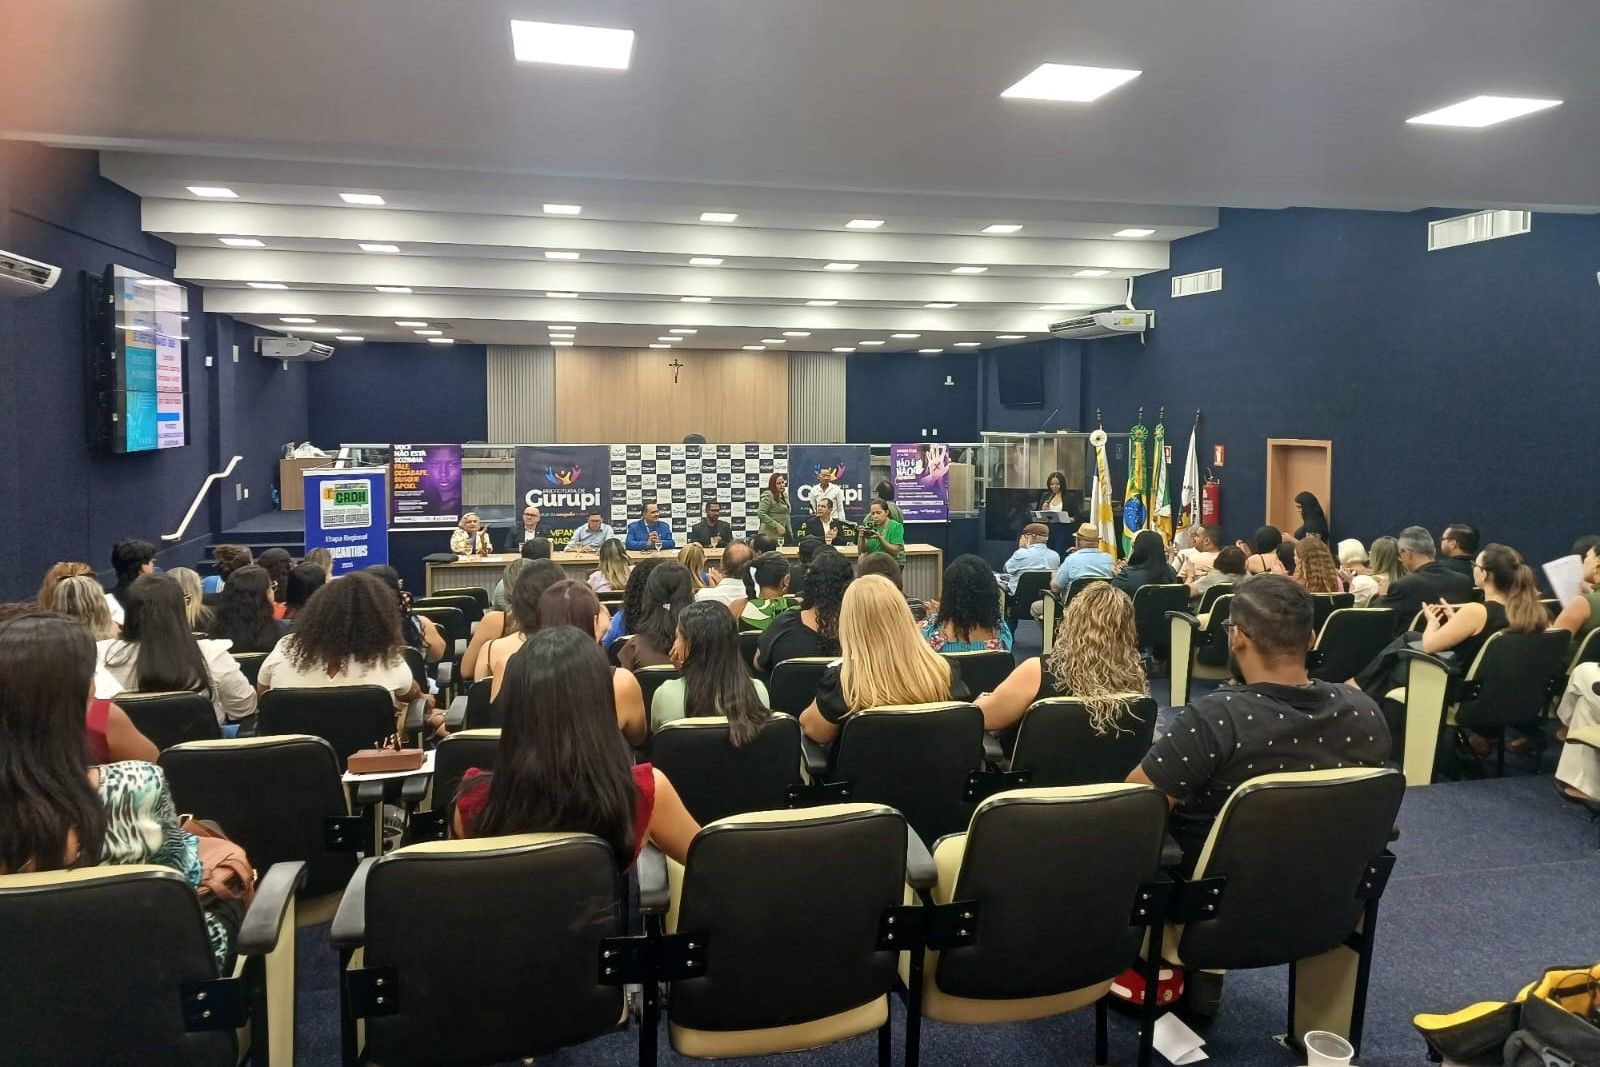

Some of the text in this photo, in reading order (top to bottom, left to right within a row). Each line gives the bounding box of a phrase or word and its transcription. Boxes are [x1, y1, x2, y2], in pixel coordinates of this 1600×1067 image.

[525, 487, 601, 511] Gurupi
[325, 533, 368, 543] Etapa Regional
